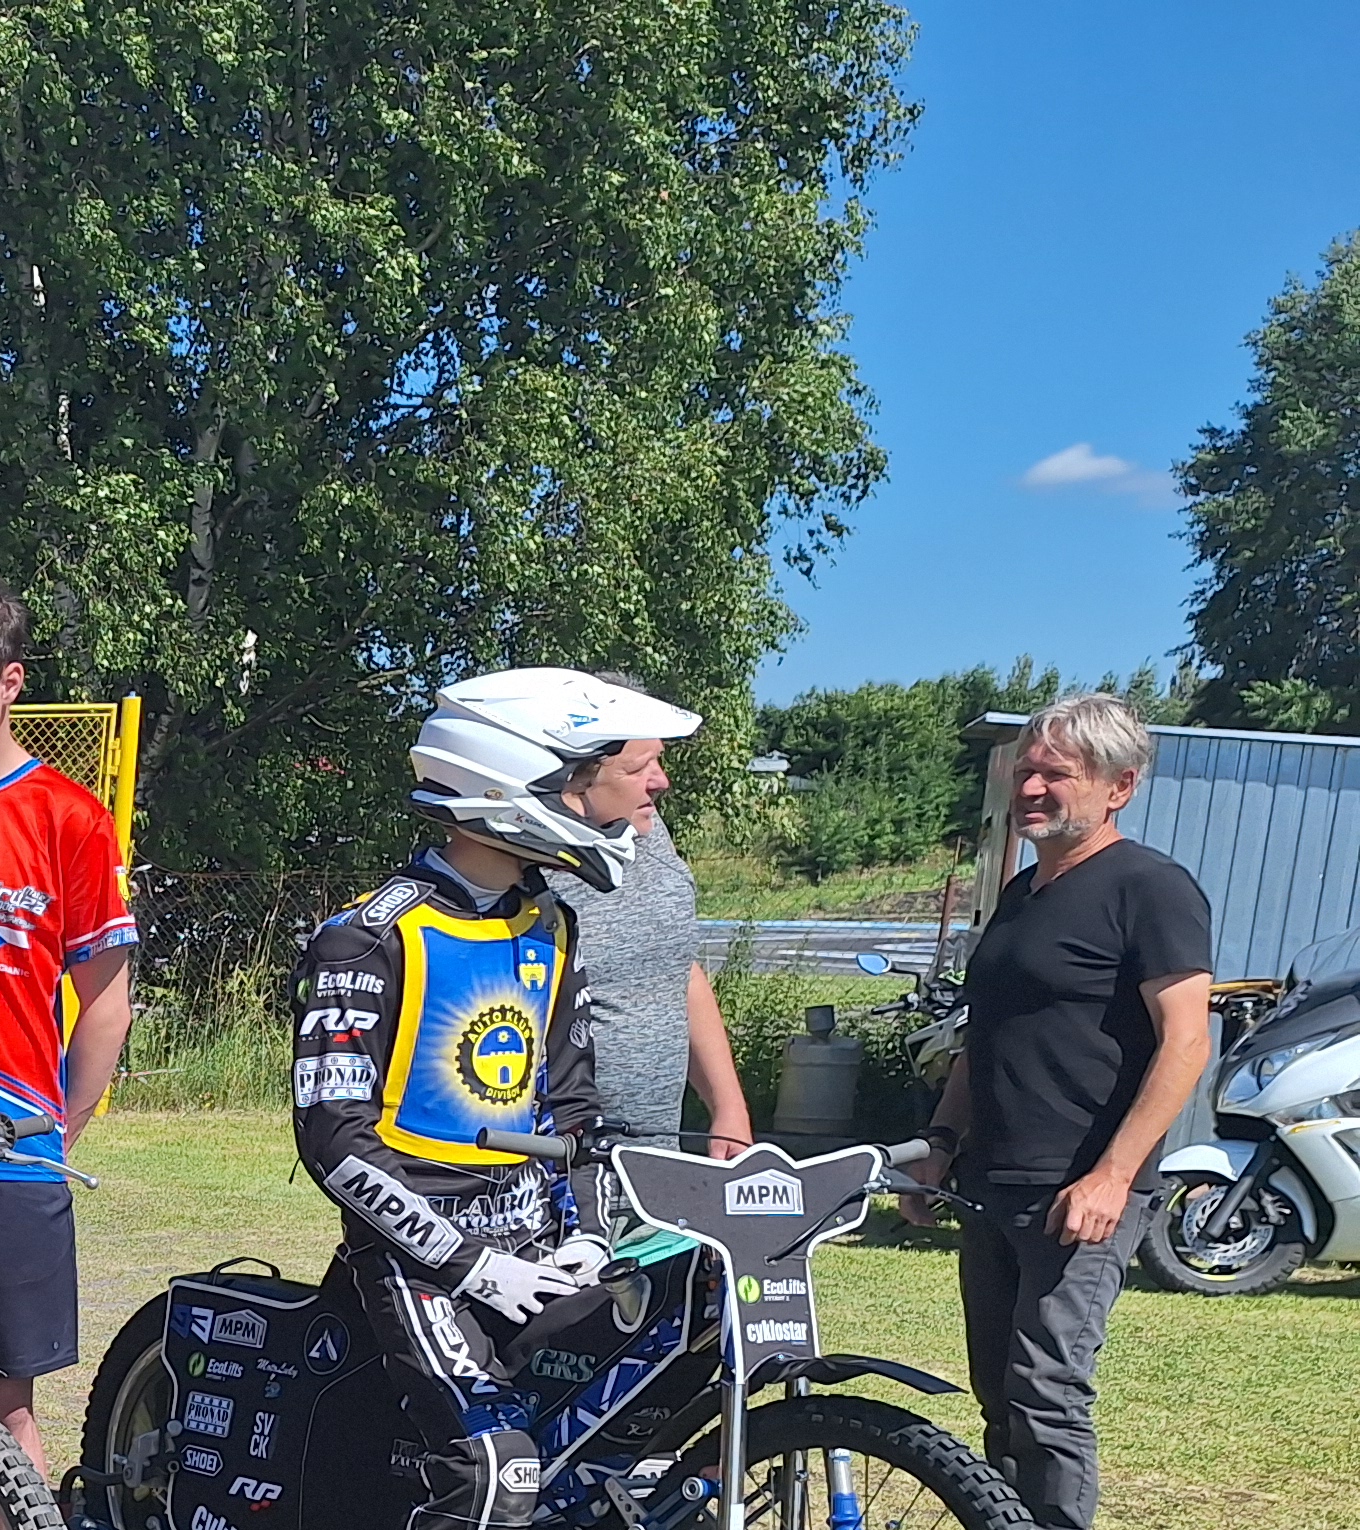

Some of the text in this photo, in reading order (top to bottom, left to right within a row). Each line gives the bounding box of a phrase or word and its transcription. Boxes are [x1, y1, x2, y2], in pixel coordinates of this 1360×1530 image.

[368, 886, 412, 922] SHOEI
[735, 1184, 791, 1206] MPM
[341, 1170, 437, 1249] MPM
[763, 1278, 807, 1296] EcoLifts
[218, 1317, 257, 1341] MPM
[746, 1318, 808, 1345] cyklostar
[206, 1357, 245, 1379] EcoLifts
[187, 1402, 230, 1424] PRONAD
[253, 1411, 276, 1437] SV
[248, 1434, 271, 1460] CK
[184, 1448, 218, 1473] SHOEI
